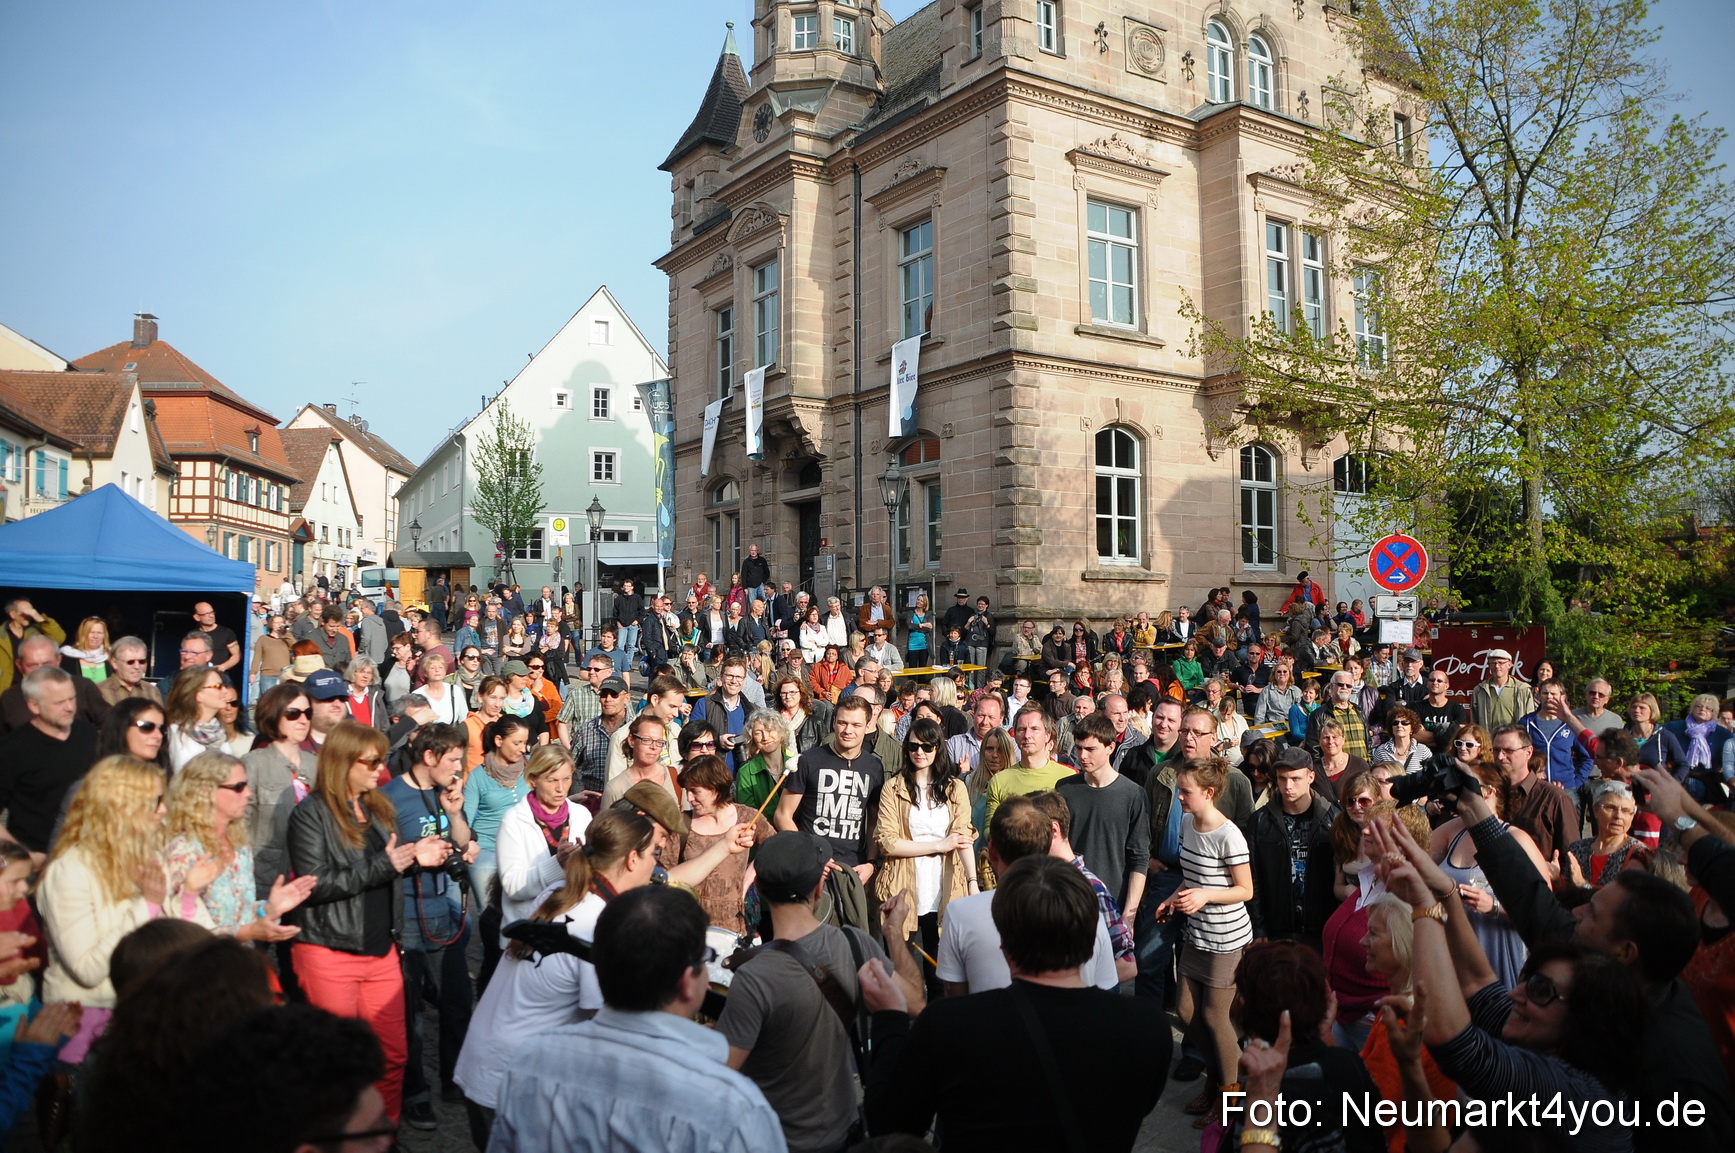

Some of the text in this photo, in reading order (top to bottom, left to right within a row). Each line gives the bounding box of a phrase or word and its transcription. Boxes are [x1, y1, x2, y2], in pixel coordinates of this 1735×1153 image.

[817, 768, 870, 798] DEN
[815, 792, 850, 820] IM
[812, 816, 862, 840] CLTH
